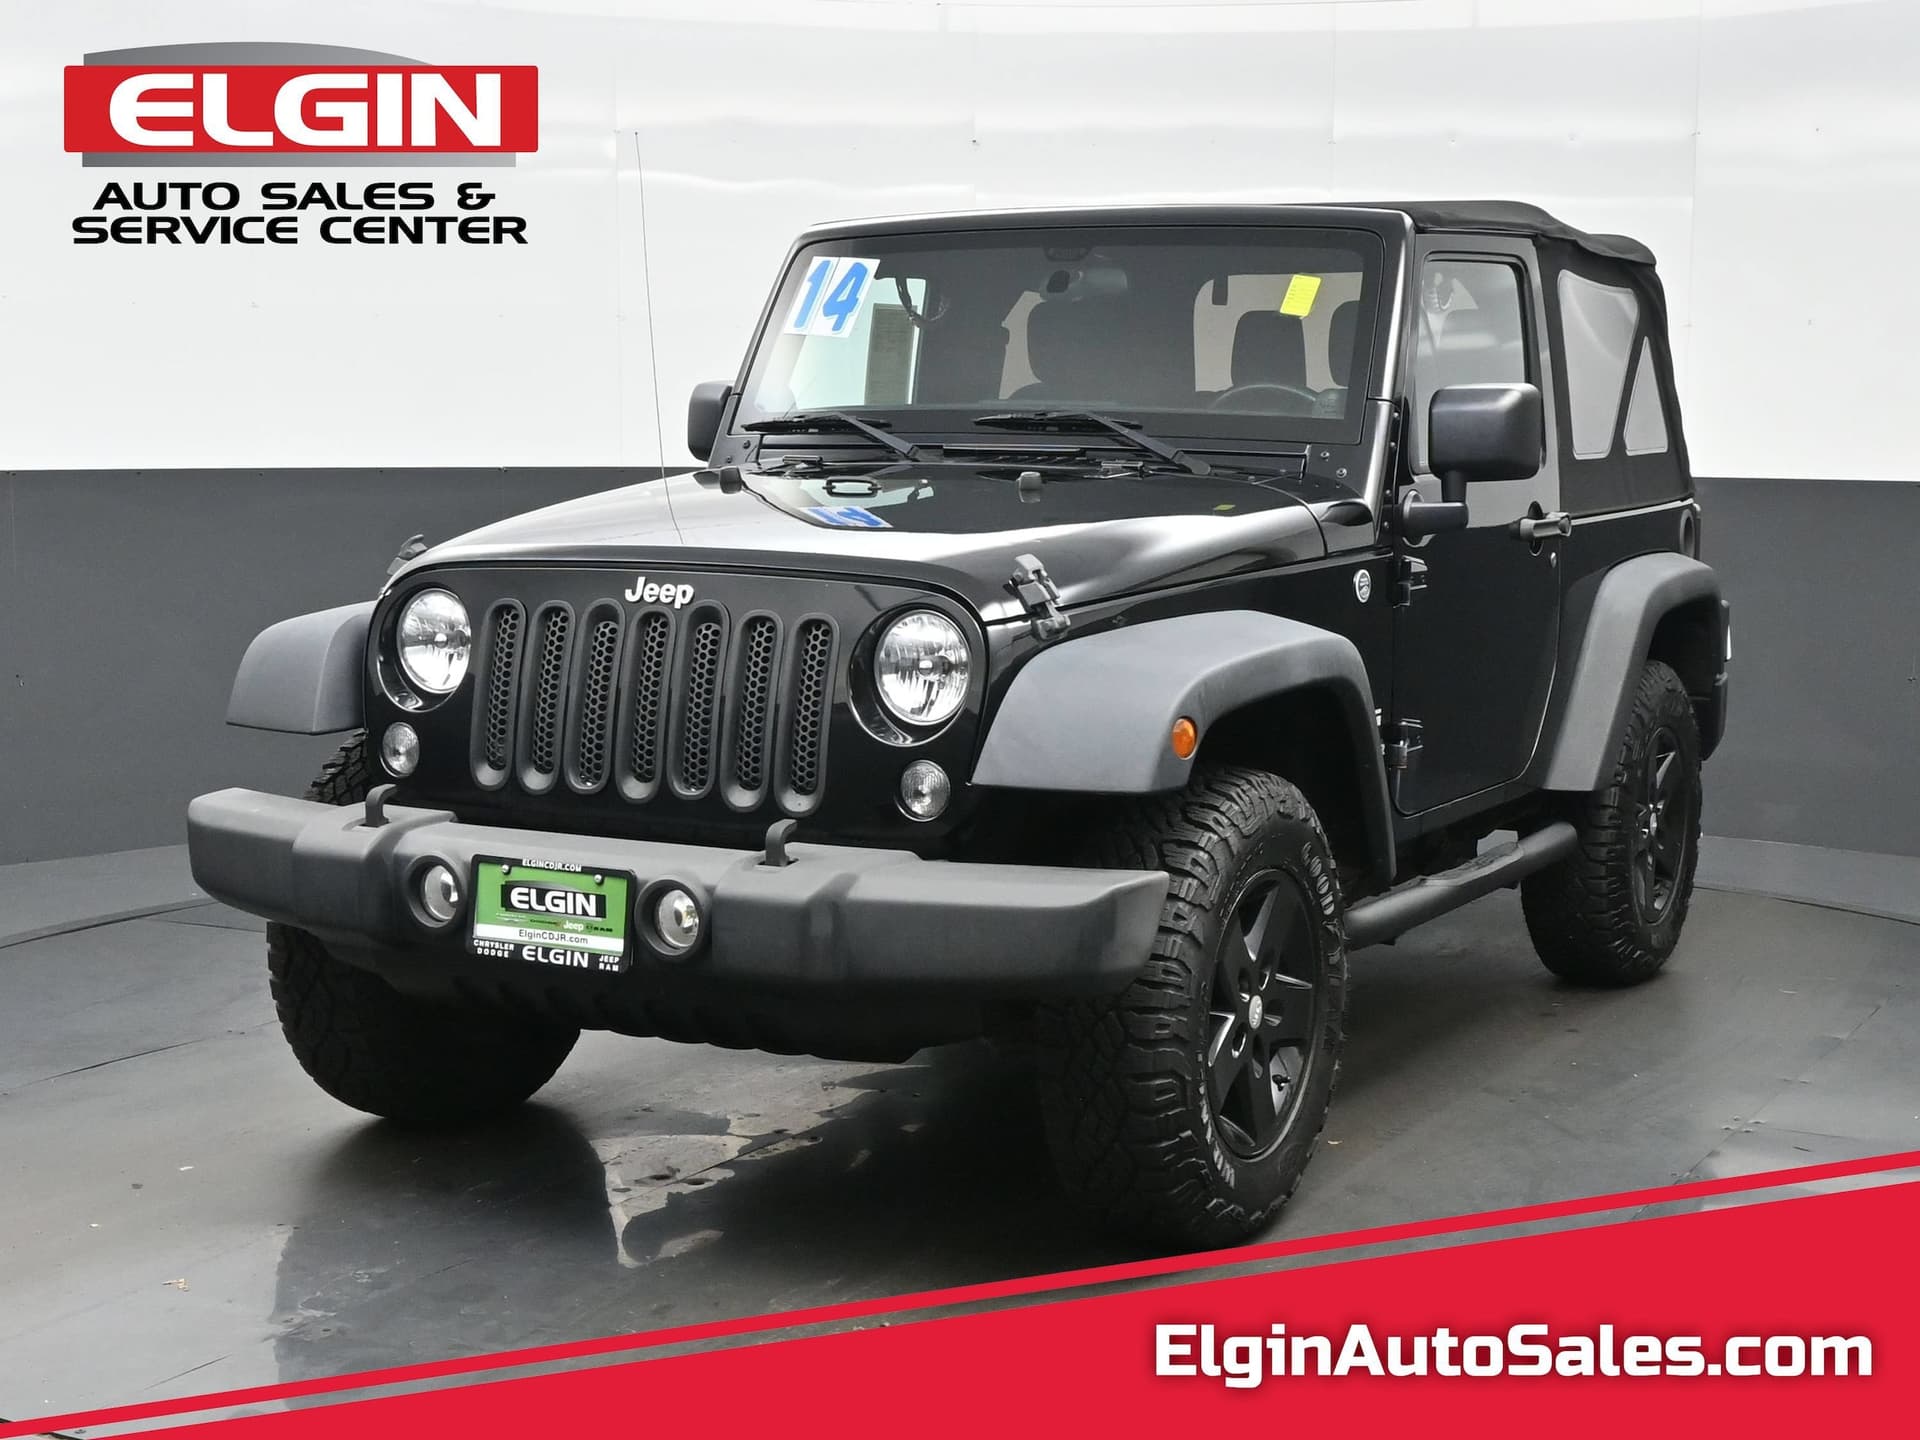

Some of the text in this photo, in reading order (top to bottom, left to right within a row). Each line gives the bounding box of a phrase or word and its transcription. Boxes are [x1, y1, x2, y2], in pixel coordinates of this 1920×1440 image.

[793, 259, 869, 332] 14
[624, 575, 695, 609] Jeep
[522, 858, 582, 872] ELGINCDJR.COM
[510, 886, 597, 917] ELGIN
[563, 919, 585, 932] Jeep
[519, 929, 589, 945] ElginCDJR.com
[473, 939, 515, 951] CHRYSLER
[477, 947, 510, 958] DODGE
[522, 945, 589, 968] ELGIN
[598, 955, 620, 964] JEEP
